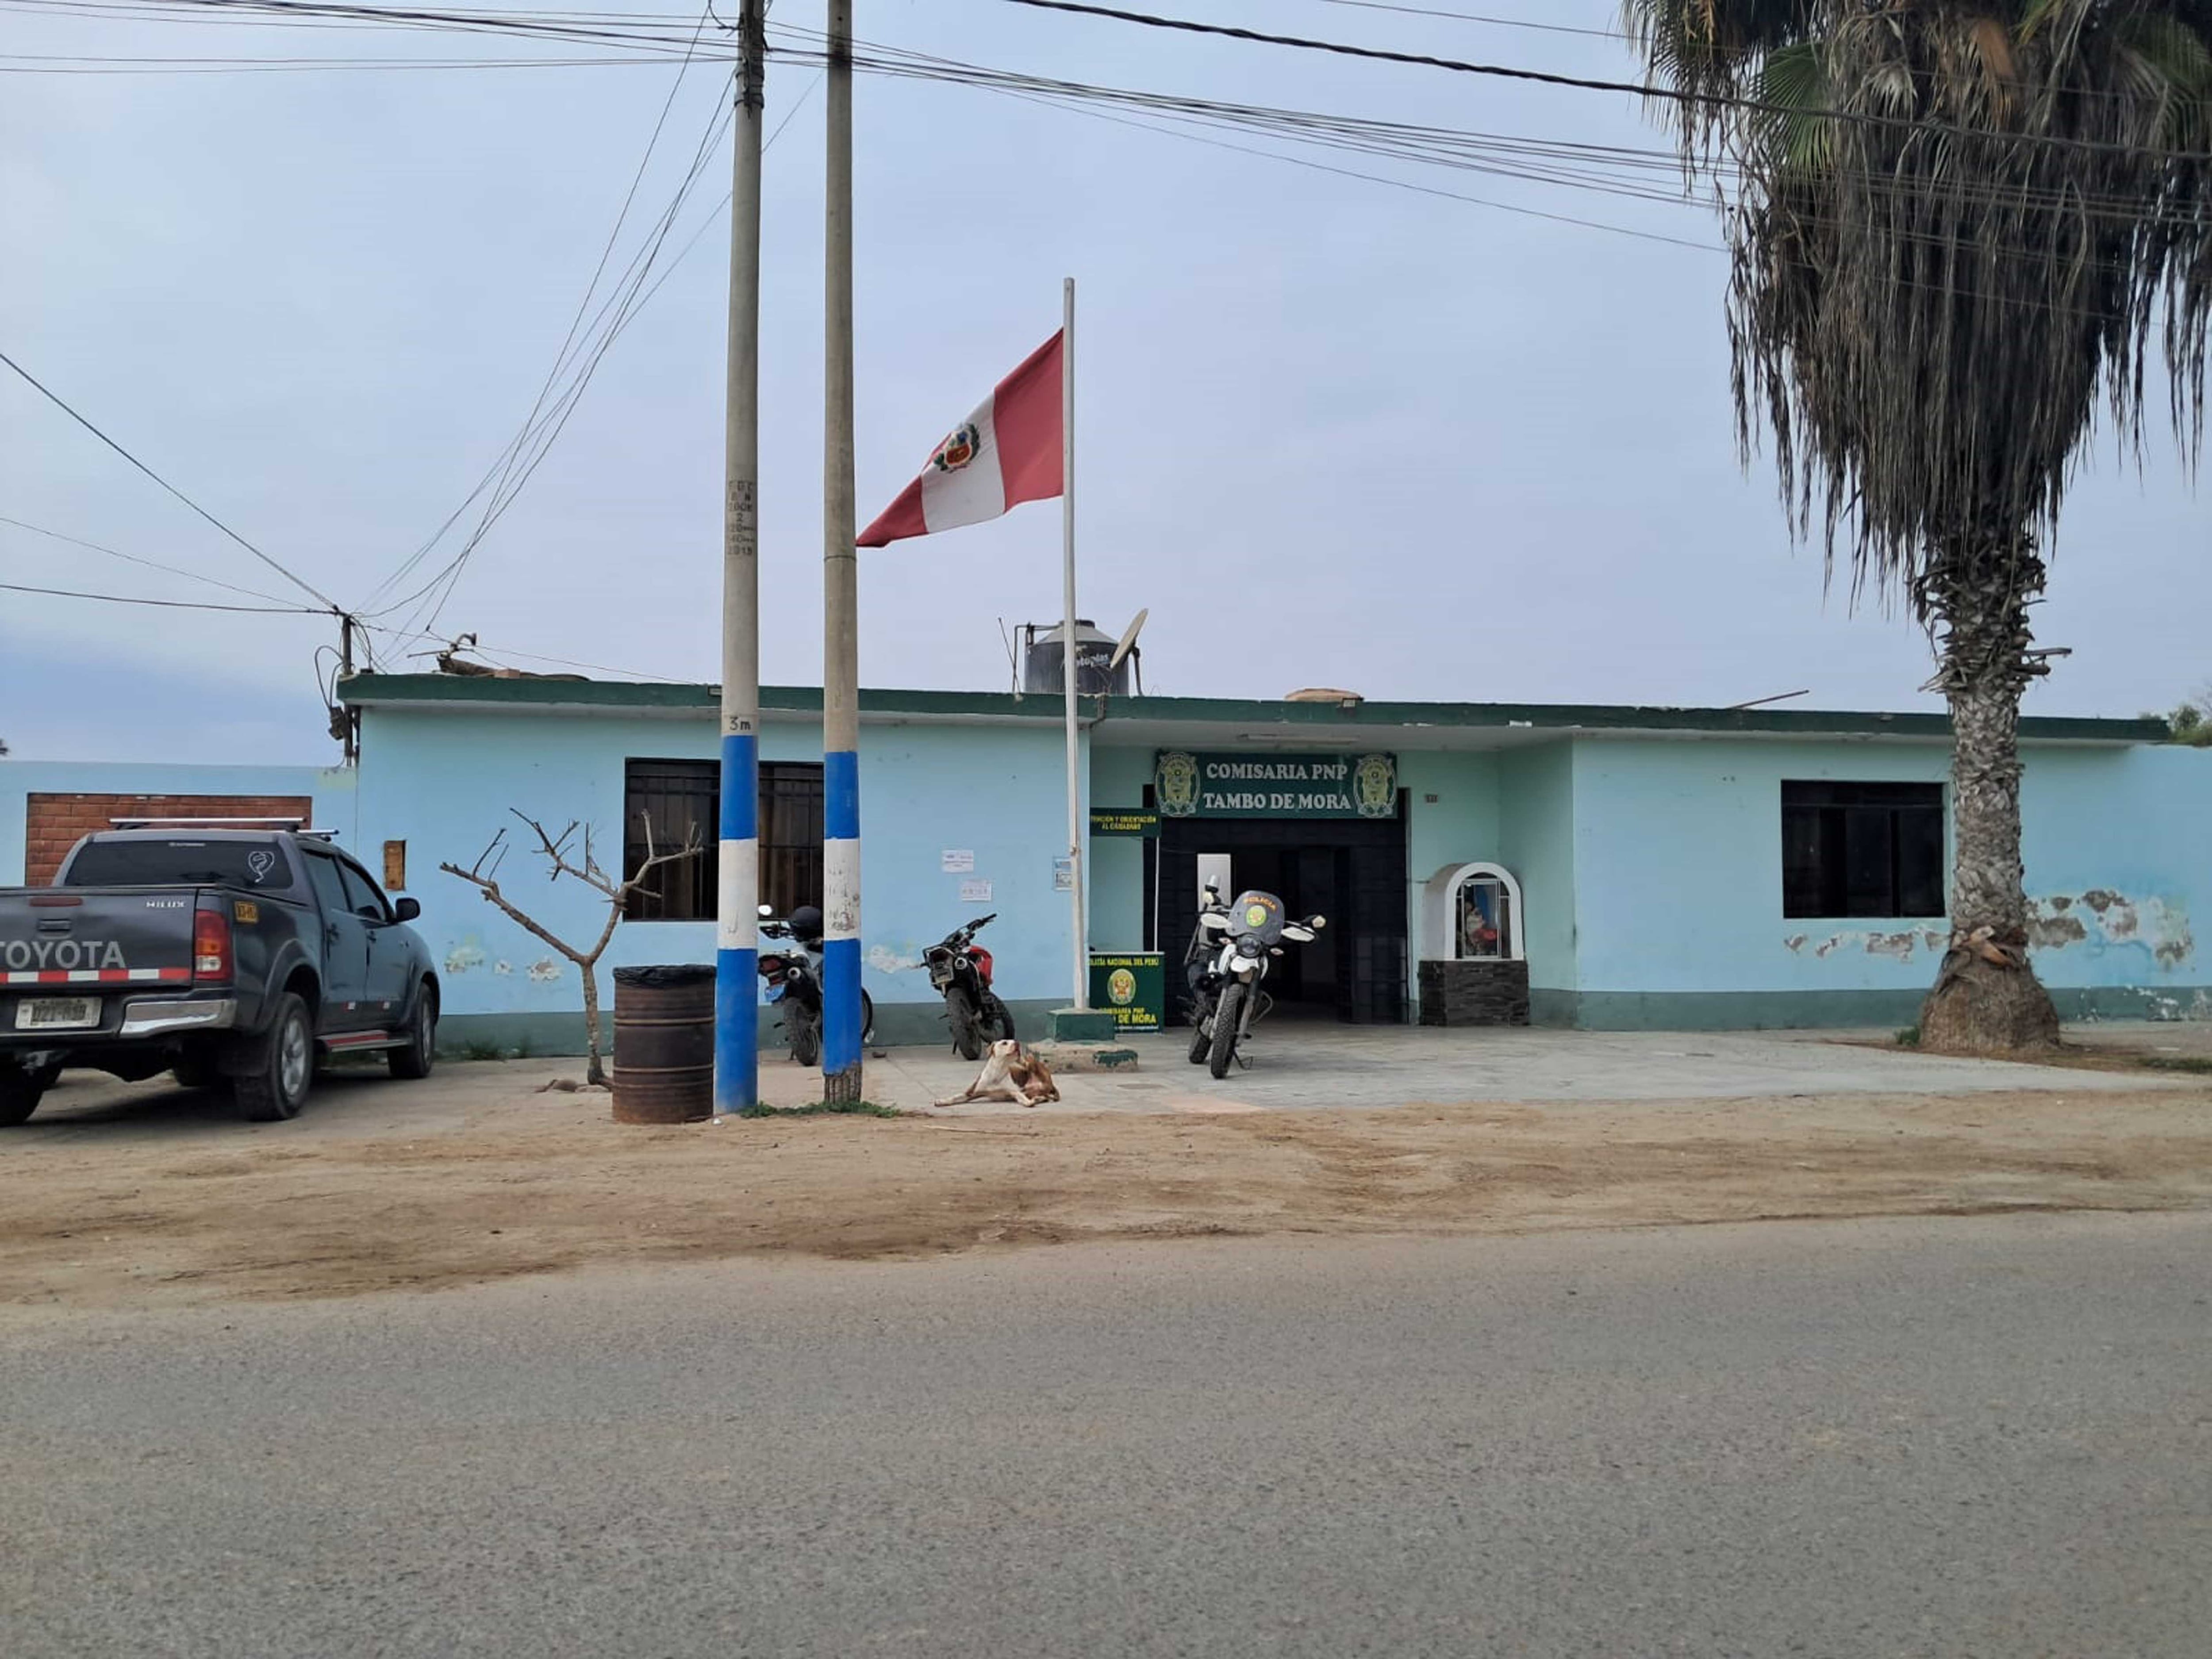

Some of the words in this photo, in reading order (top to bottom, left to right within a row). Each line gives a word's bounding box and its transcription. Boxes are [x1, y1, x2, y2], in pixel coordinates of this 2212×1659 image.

[1206, 763, 1308, 780] COMISARIA
[1311, 764, 1348, 780] PNP
[1204, 793, 1267, 809] TAMBO
[1270, 793, 1295, 809] DE
[1298, 794, 1352, 810] MORA
[0, 940, 126, 969] OYOTA
[1118, 1014, 1129, 1024] DE
[1132, 1014, 1156, 1024] MORA
